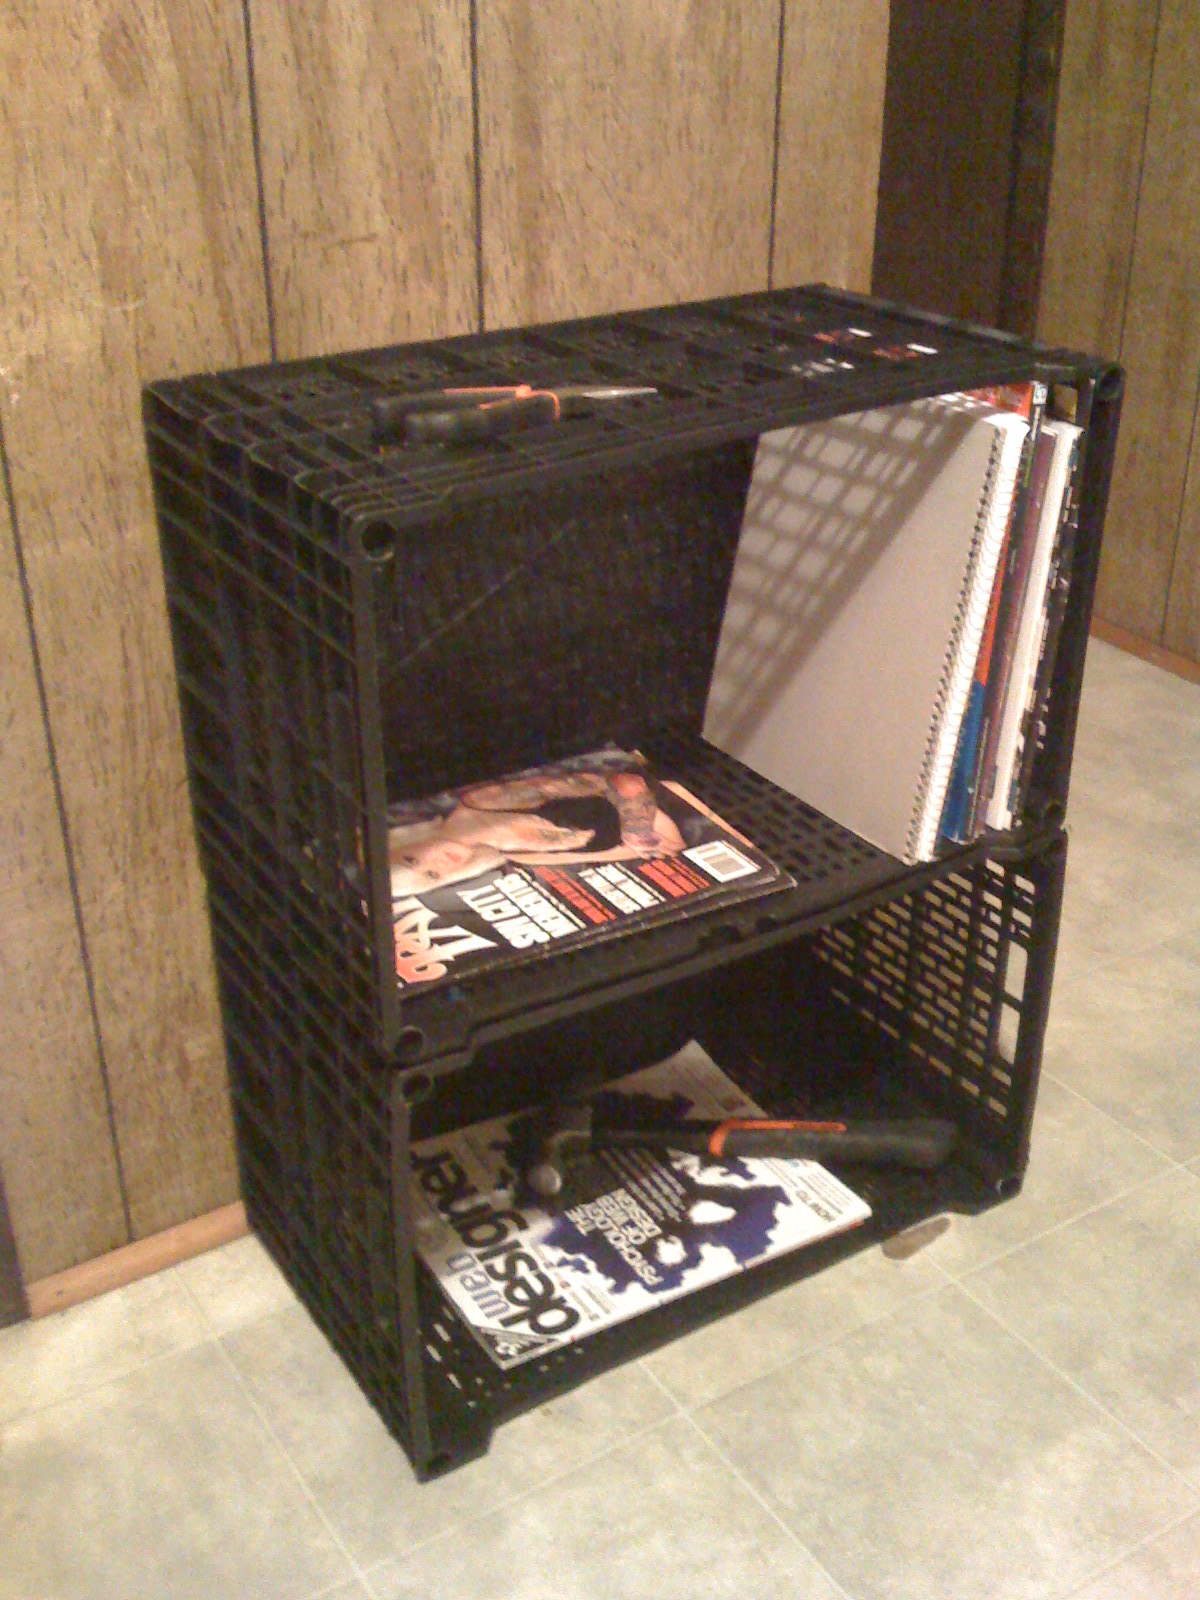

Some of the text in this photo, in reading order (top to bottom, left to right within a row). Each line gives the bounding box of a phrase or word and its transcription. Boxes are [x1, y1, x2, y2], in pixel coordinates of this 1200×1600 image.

[456, 884, 521, 922] CITY
[492, 915, 550, 949] SIN
[564, 1209, 596, 1237] THE
[597, 1194, 631, 1227] WEB
[610, 1187, 662, 1238] DESIGN
[410, 1152, 581, 1336] designer
[576, 1202, 664, 1285] PSYCHOLOGY
[621, 1225, 647, 1245] OF
